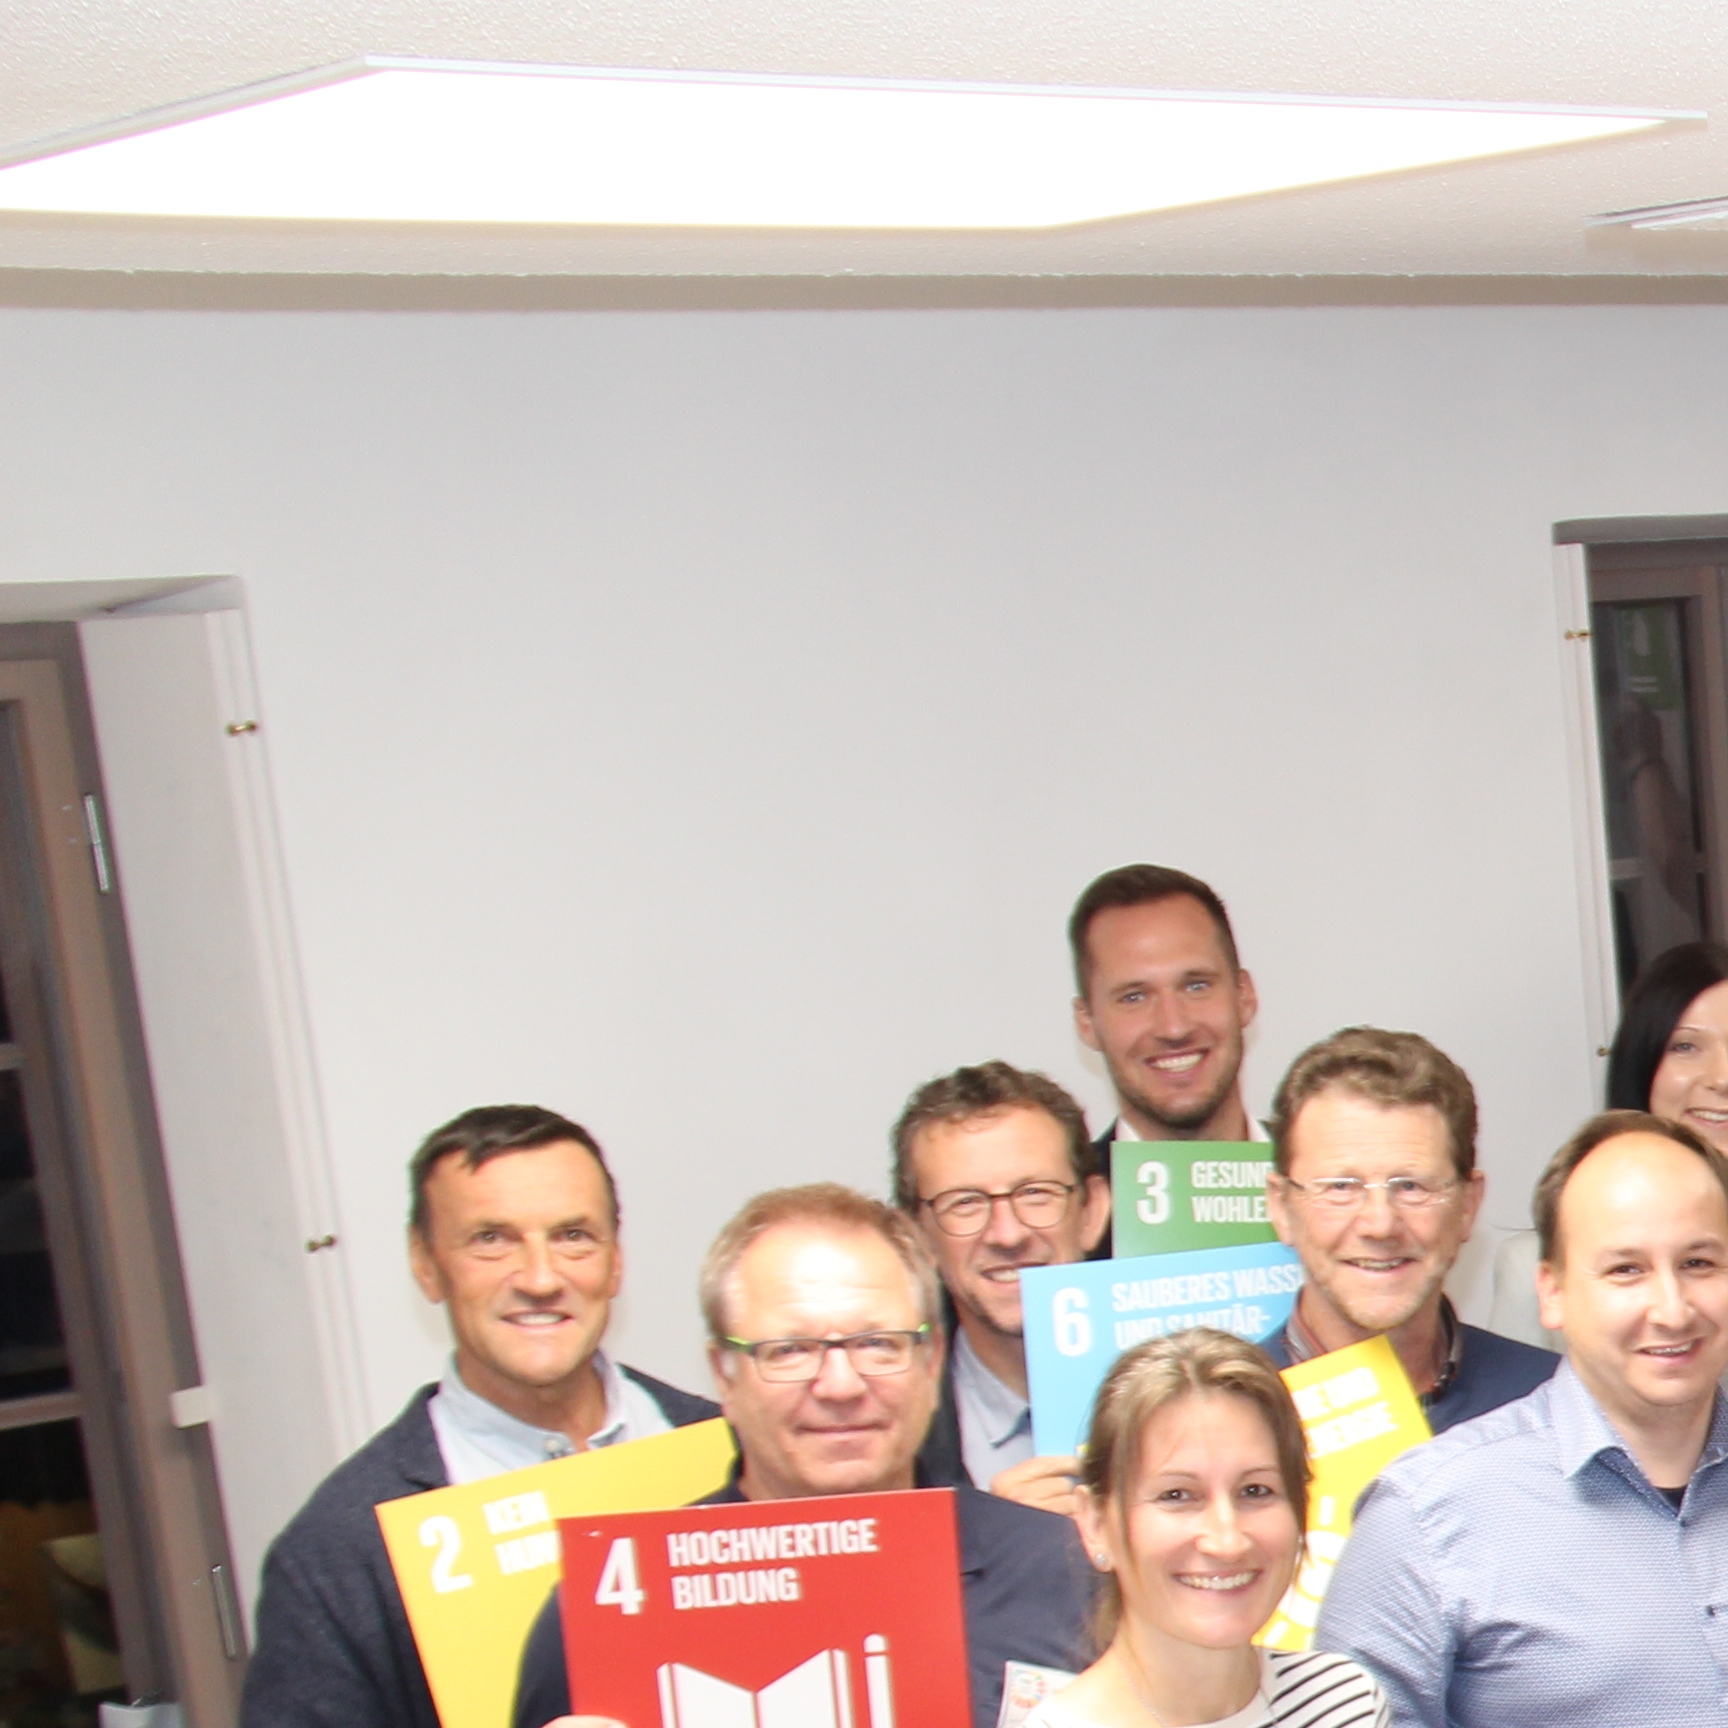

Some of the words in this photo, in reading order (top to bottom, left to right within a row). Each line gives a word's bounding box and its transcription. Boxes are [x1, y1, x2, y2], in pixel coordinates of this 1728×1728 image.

[1136, 1161, 1170, 1224] 3
[1191, 1196, 1270, 1222] WOHLE
[1111, 1271, 1232, 1312] SAUBERES
[1051, 1287, 1091, 1356] 6
[418, 1515, 473, 1593] 2
[666, 1518, 879, 1567] HOCHWERTIGE
[595, 1537, 644, 1615] 4
[671, 1568, 800, 1610] BILDUNG
